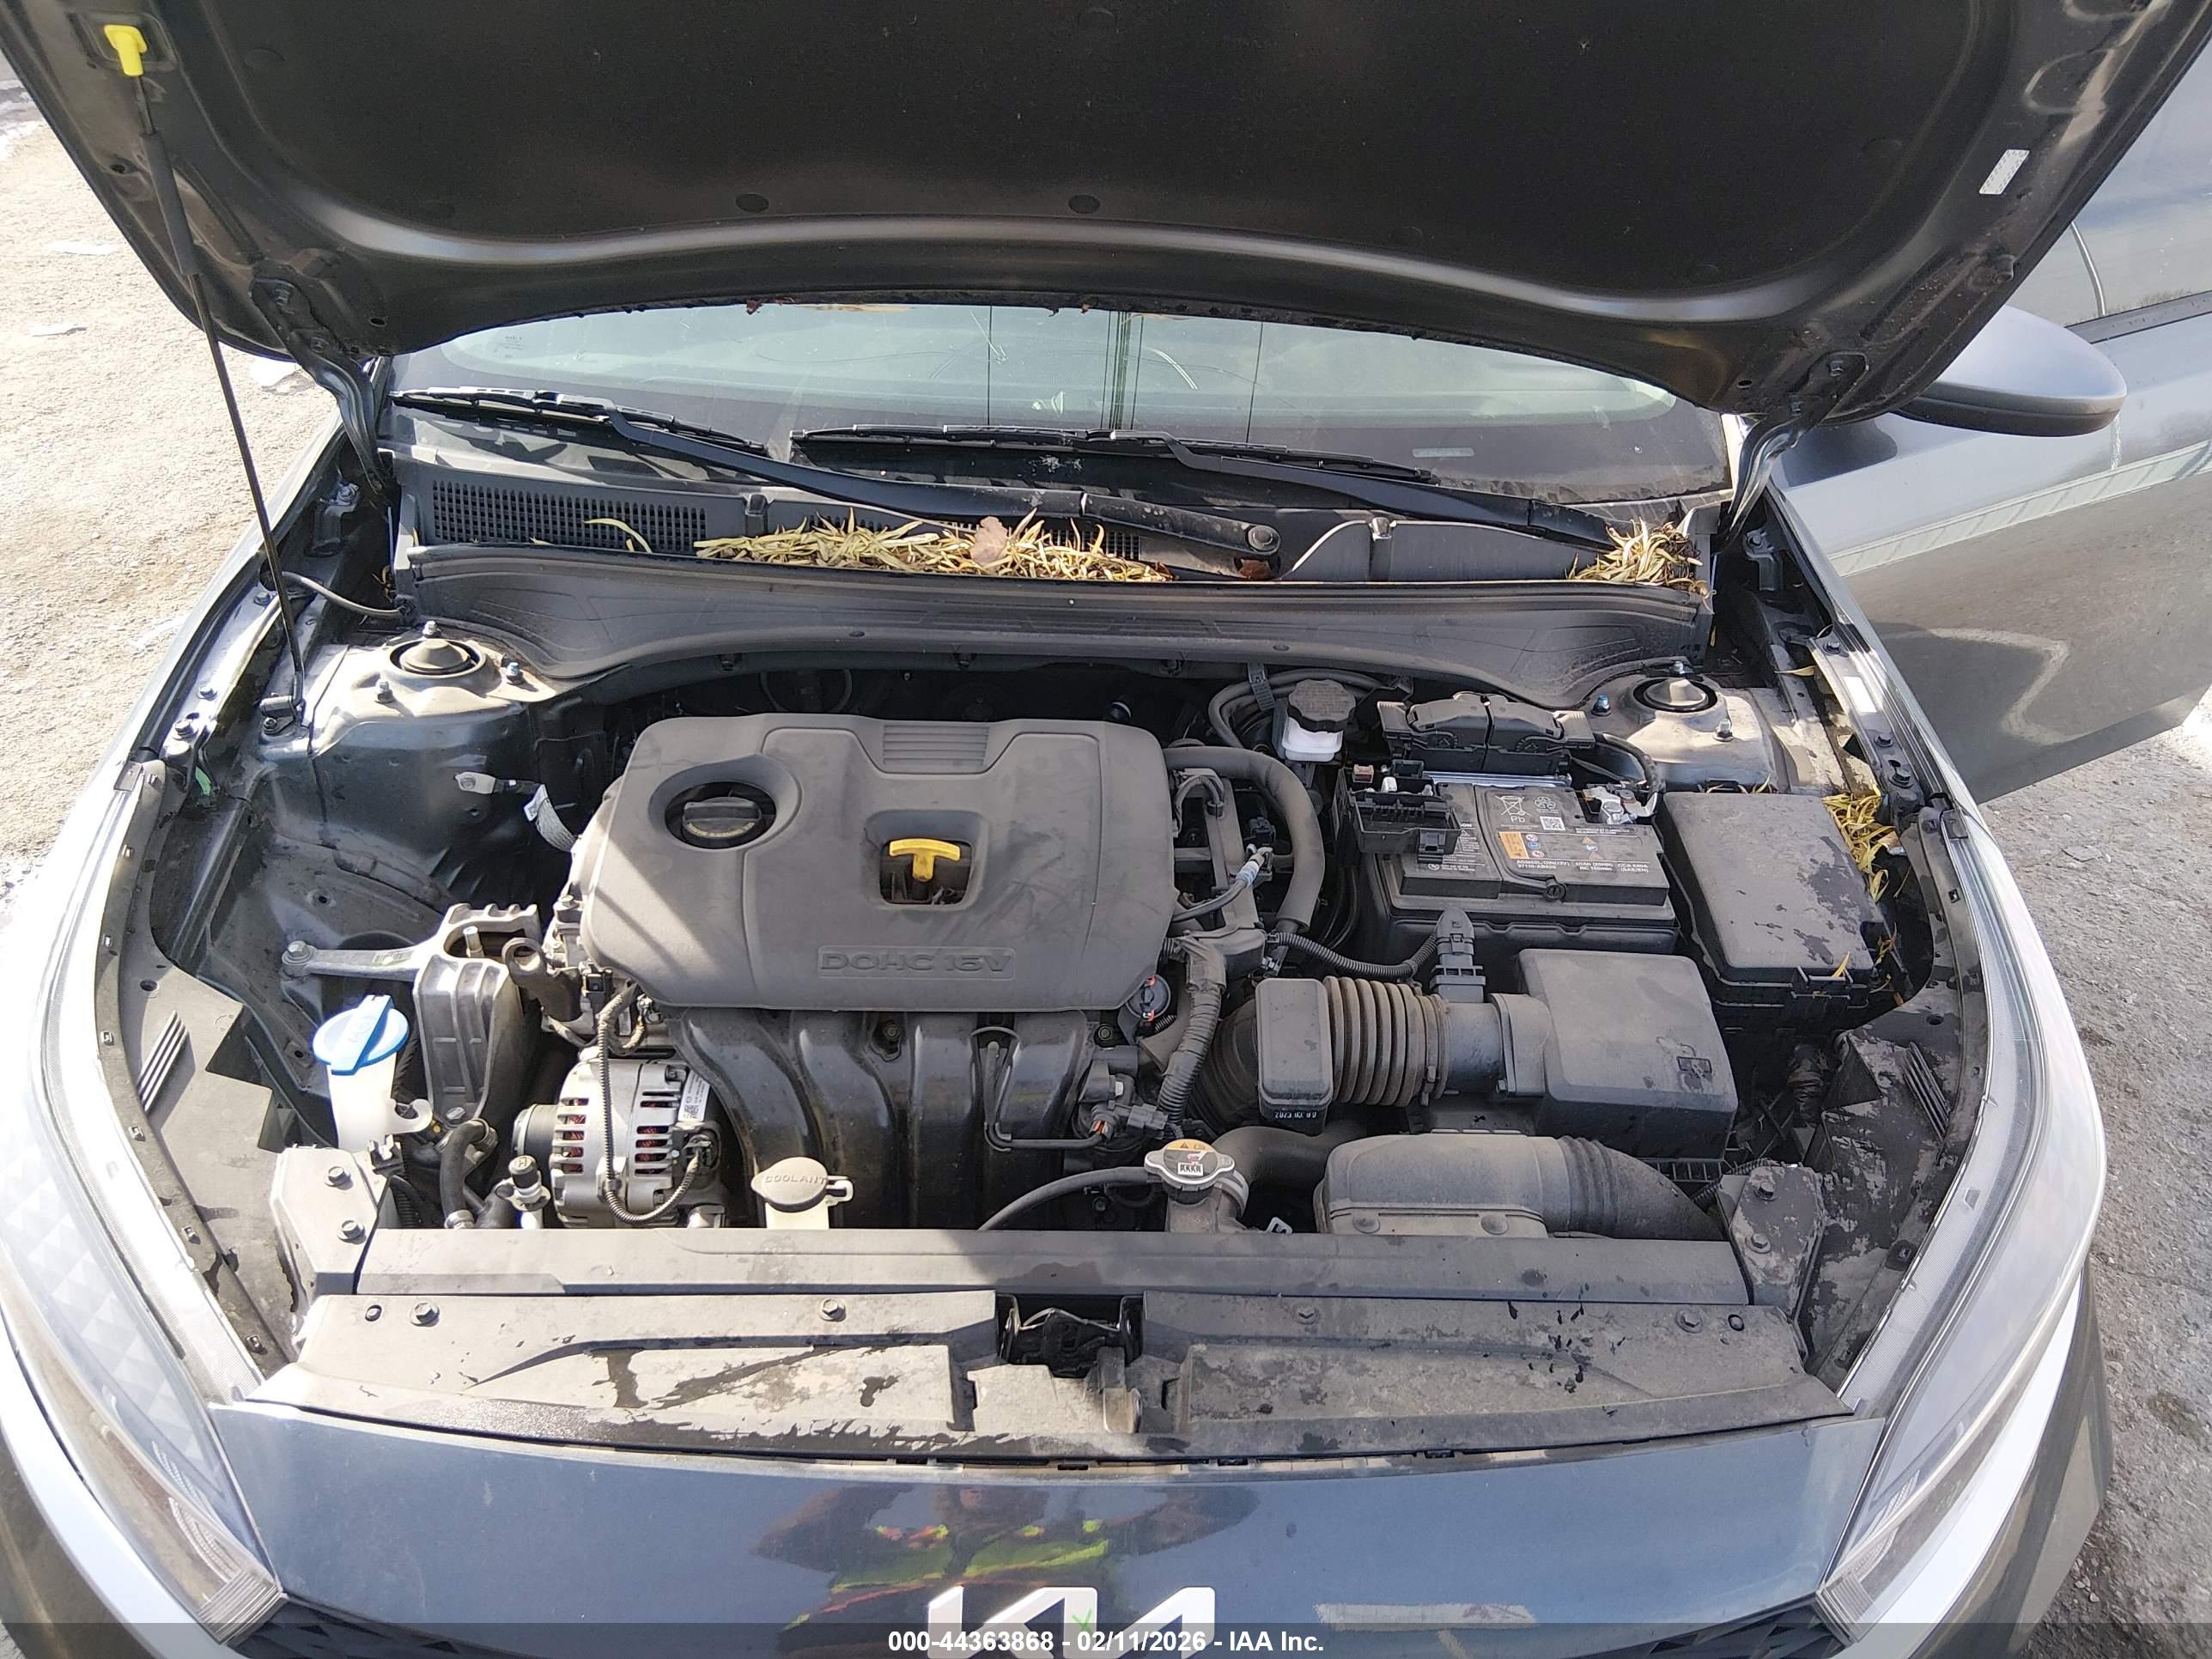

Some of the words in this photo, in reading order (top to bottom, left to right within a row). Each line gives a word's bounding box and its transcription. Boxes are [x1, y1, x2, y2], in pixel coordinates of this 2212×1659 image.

[820, 952, 935, 970] DOHC
[945, 954, 1012, 972] 16V
[765, 1174, 828, 1185] COOLANT
